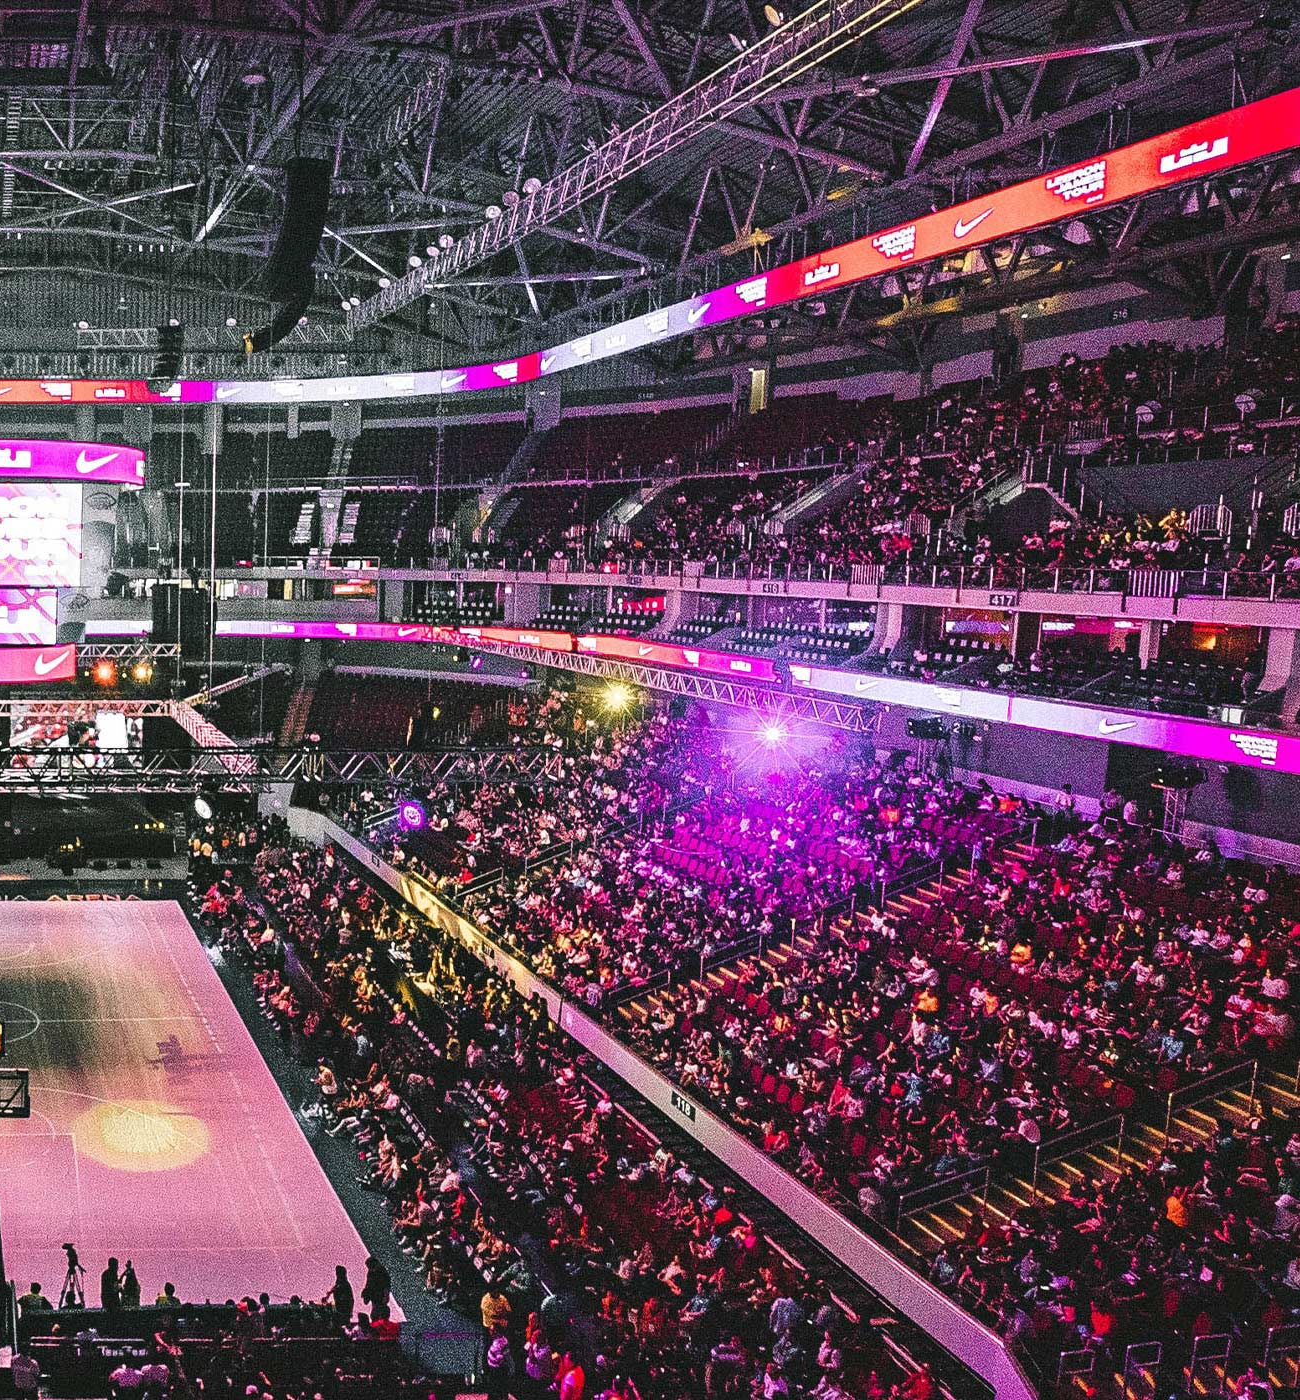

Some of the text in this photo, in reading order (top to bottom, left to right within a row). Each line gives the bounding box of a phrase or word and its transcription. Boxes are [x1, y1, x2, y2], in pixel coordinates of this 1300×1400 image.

[991, 595, 1013, 606] 417
[952, 722, 974, 736] 217
[676, 1096, 691, 1116] 118
